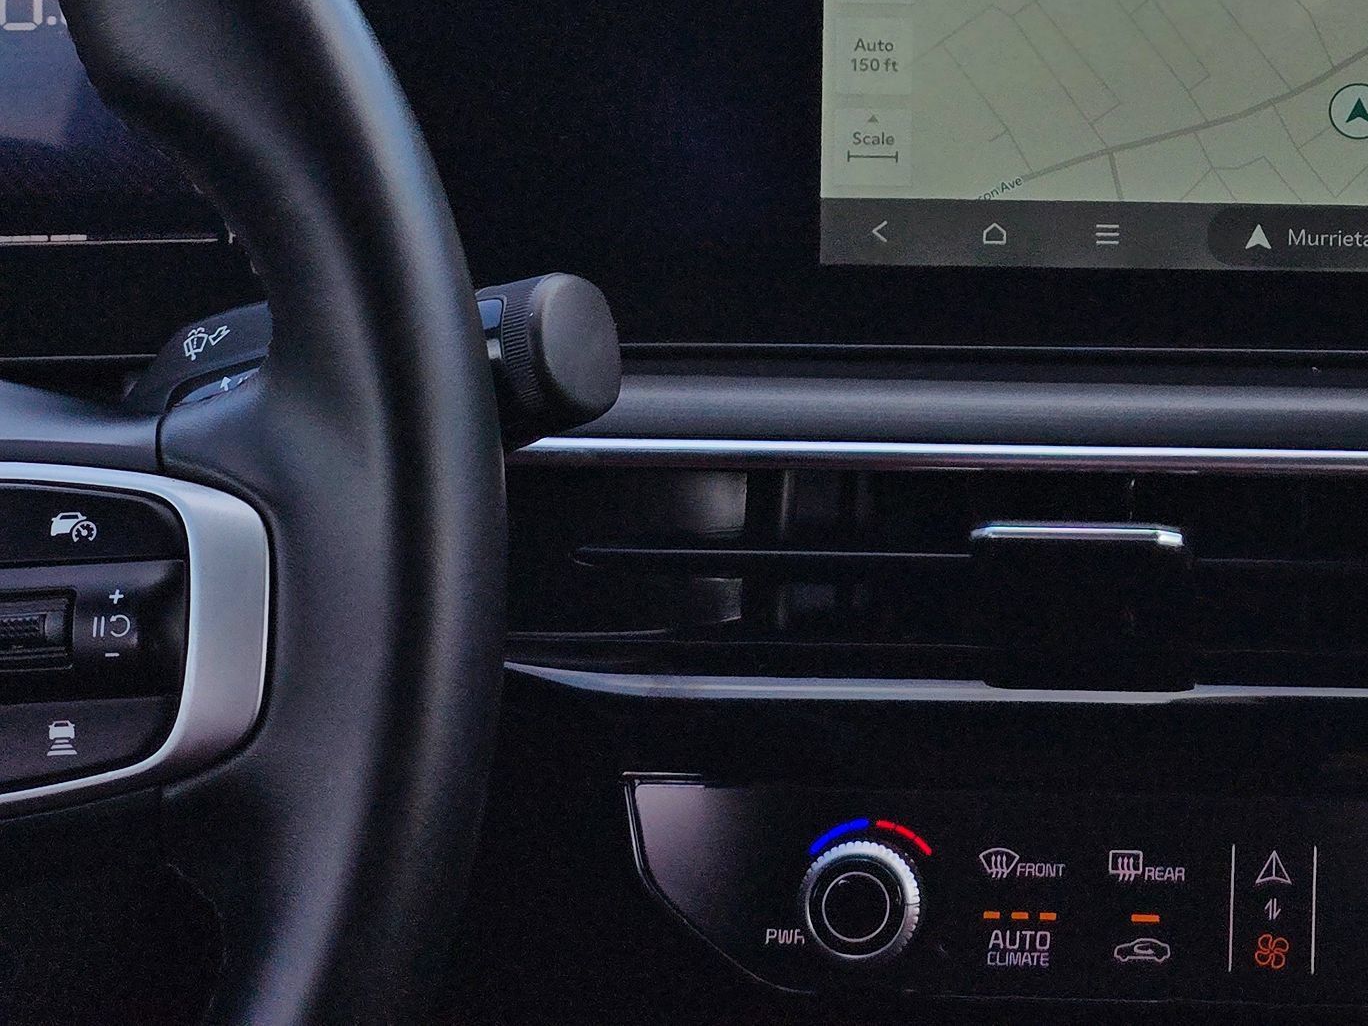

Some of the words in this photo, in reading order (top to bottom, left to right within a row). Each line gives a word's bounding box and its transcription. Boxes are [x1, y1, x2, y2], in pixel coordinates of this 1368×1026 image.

[853, 37, 895, 53] Auto
[851, 57, 881, 73] 150
[884, 57, 899, 73] ft
[852, 131, 896, 146] Scale
[1000, 176, 1023, 193] Ave
[1015, 862, 1067, 878] FRONT
[1143, 866, 1186, 882] REAR
[988, 929, 1051, 950] AUTO
[986, 951, 1050, 967] CLIMATE
